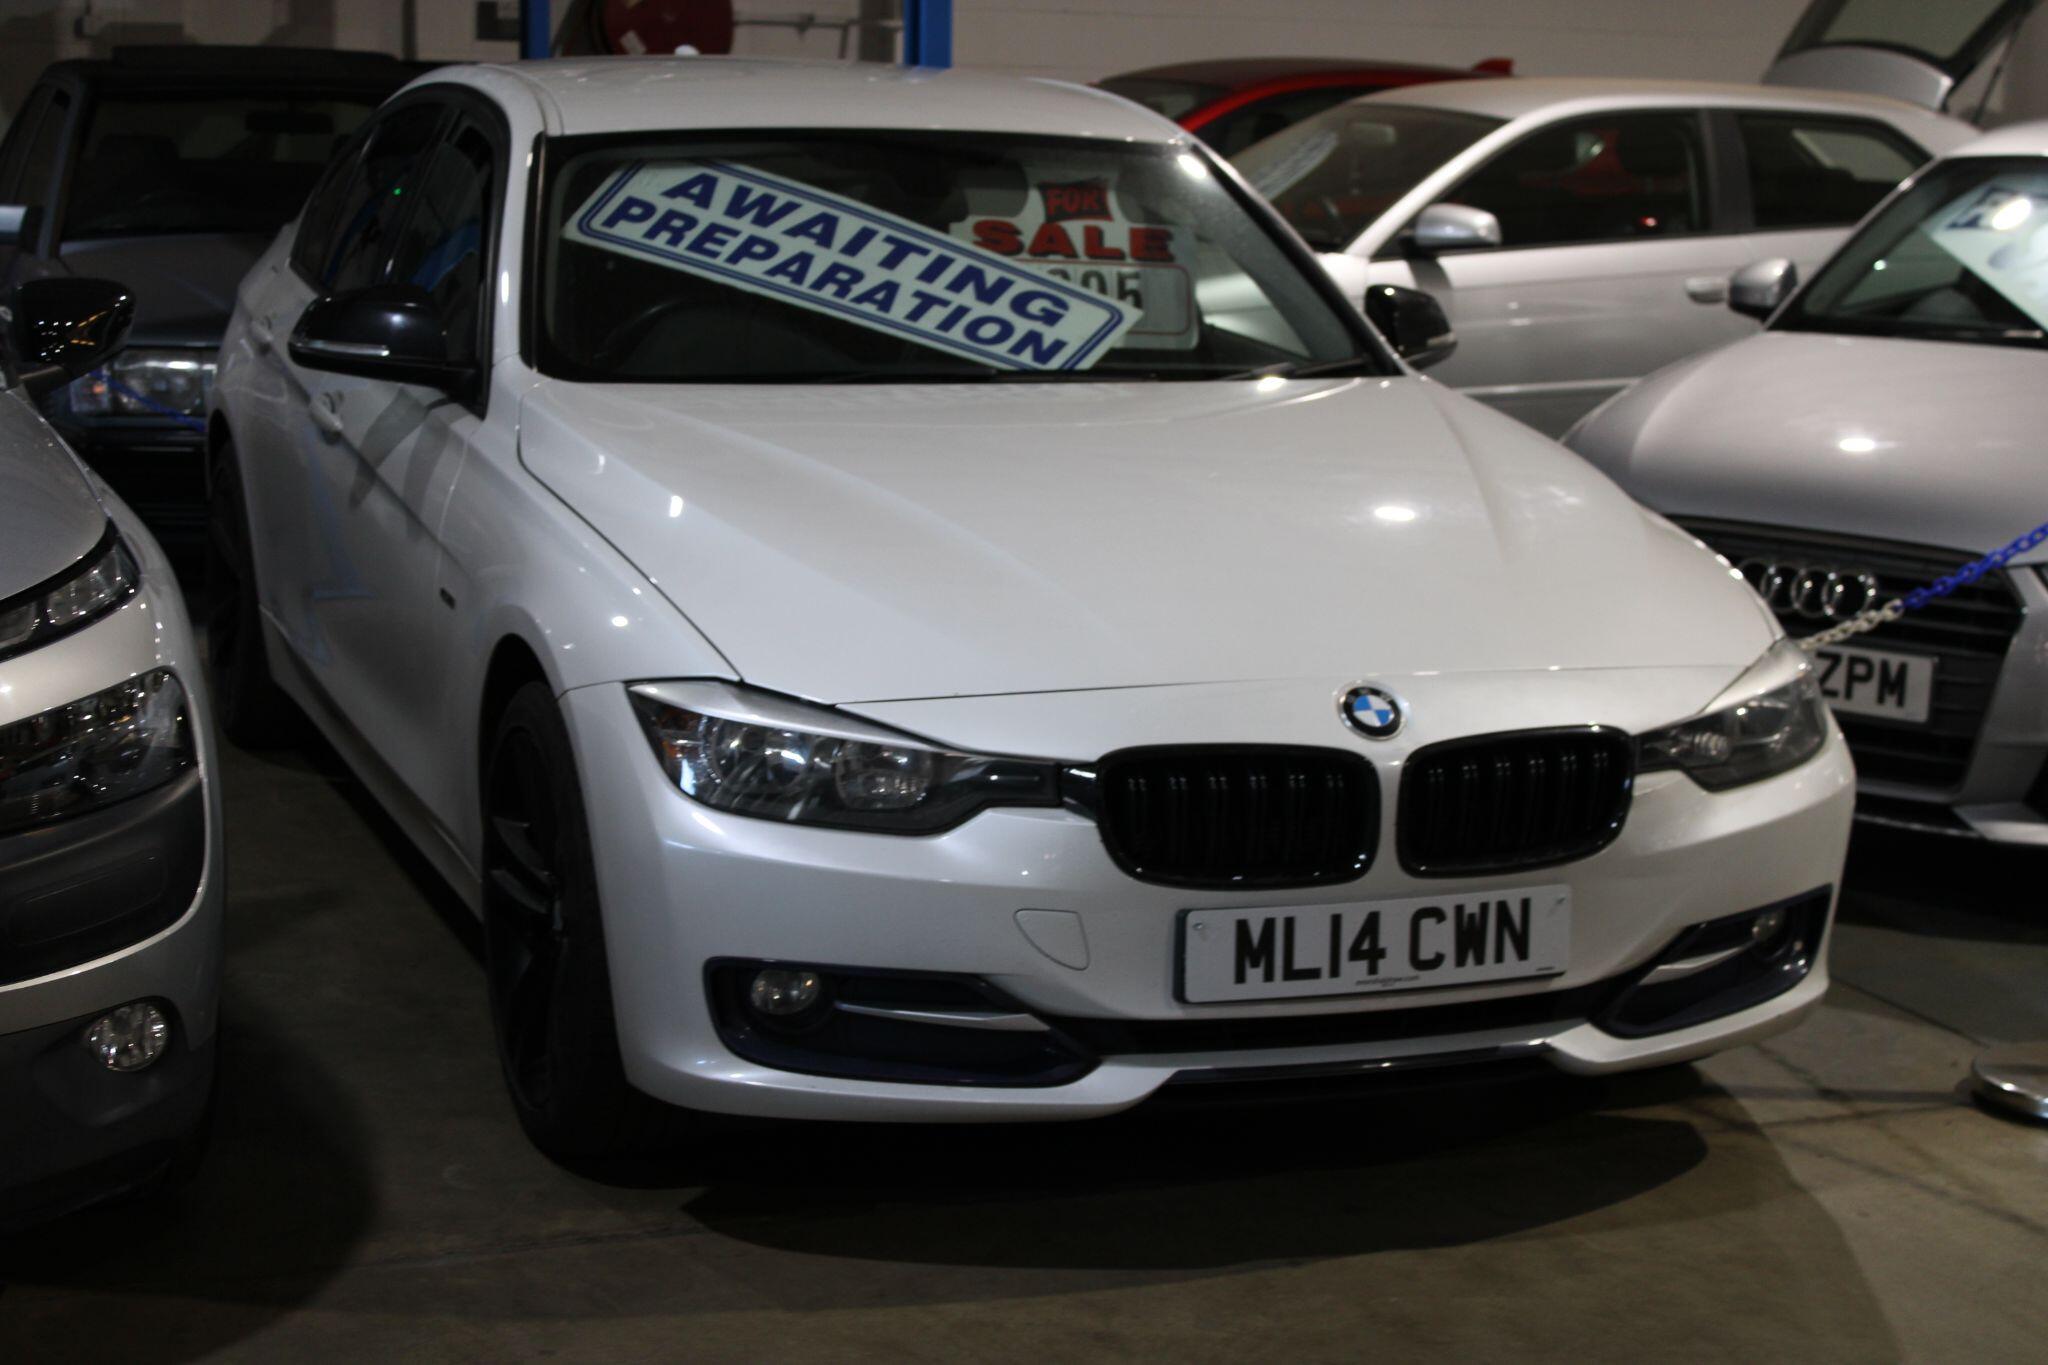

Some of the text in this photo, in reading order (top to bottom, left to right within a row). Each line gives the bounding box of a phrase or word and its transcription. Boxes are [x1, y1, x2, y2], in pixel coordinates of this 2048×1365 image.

[600, 195, 1068, 366] PREPARATION
[659, 172, 1070, 328] AWAITING
[972, 218, 1176, 262] SALE
[1815, 650, 1908, 709] ZPM
[1234, 897, 1531, 985] ML14 CWN
